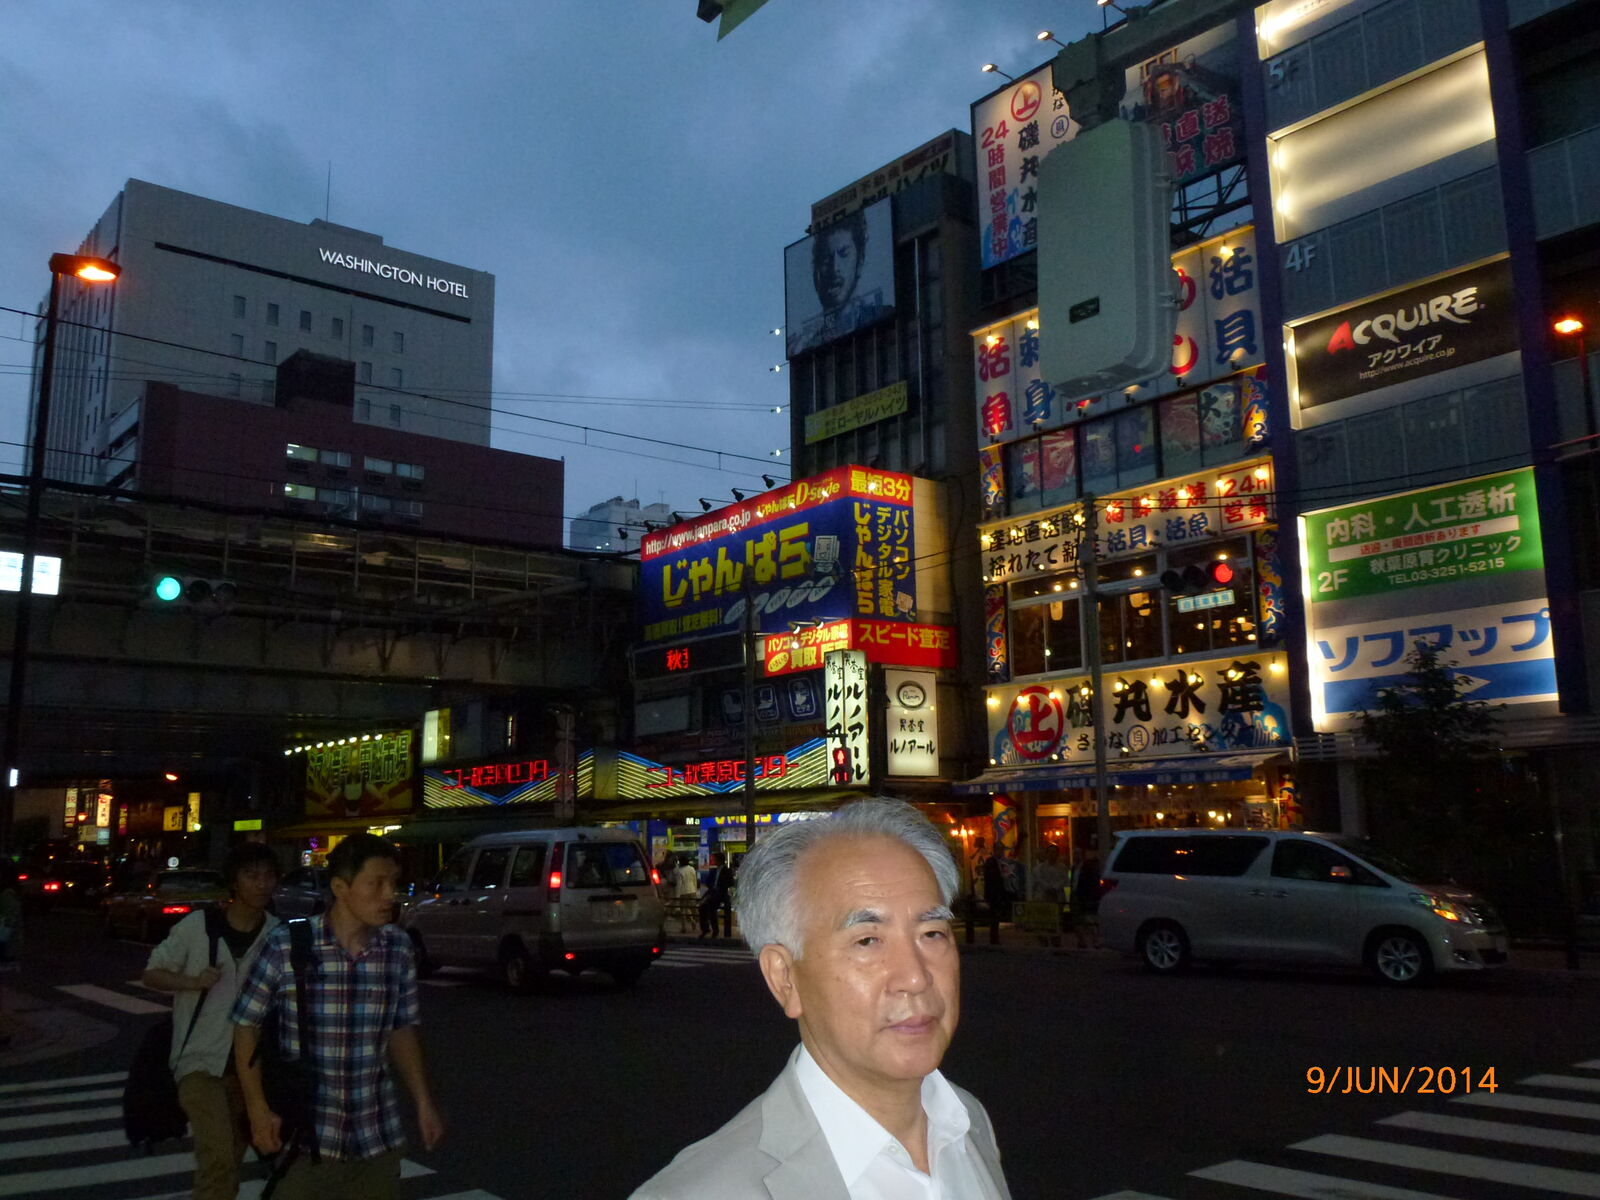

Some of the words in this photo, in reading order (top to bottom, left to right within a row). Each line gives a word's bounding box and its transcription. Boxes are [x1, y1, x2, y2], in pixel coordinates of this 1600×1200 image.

[319, 247, 423, 288] WASHINGTON
[426, 275, 470, 299] HOTEL
[1284, 241, 1318, 273] 4F
[1209, 246, 1257, 365] 活貝
[1327, 286, 1478, 356] ACQUIRE
[1358, 345, 1456, 381] http://www.acquire.co.jp
[1367, 333, 1444, 369] アクワイア
[850, 470, 912, 502] 最短3分
[645, 508, 752, 555] http://www.janpara.co.jp
[1325, 482, 1517, 546] 内科・人工透析
[661, 521, 810, 608] じゃんぱら
[853, 501, 876, 616] じゃんぱら
[876, 506, 896, 618] デジタル家電
[893, 508, 911, 582] パソコン
[989, 538, 1090, 577] 採れたて新
[1317, 568, 1349, 594] 2F
[858, 623, 951, 650] スピード査定
[1317, 607, 1550, 672] ソフマップ
[889, 738, 936, 756] ルノアール
